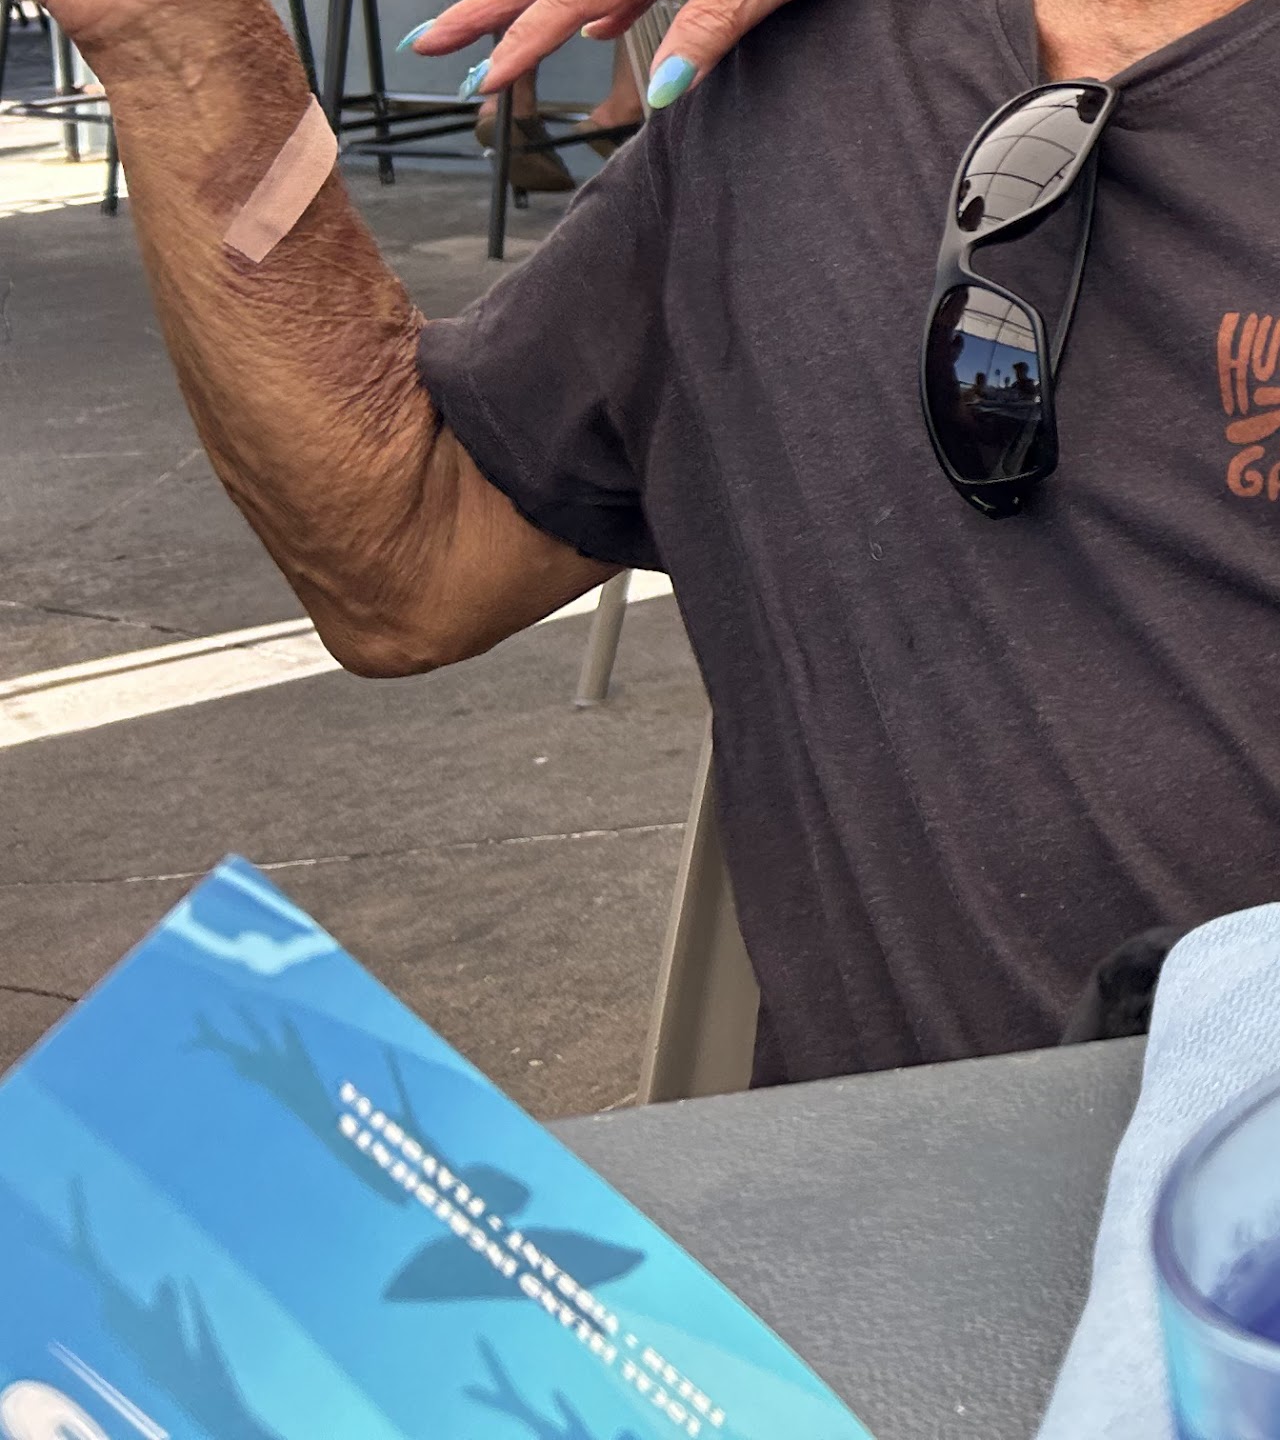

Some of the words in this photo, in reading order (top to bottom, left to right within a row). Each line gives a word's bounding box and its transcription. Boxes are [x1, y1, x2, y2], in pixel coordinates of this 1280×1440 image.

[338, 1112, 519, 1277] INGREDIENTS
[339, 1080, 487, 1217] FLAVORFUL
[506, 1229, 619, 1336] VIBRANT
[518, 1271, 618, 1366] ISLAND
[622, 1357, 702, 1438] LOCAL
[642, 1346, 727, 1429] FRESH
